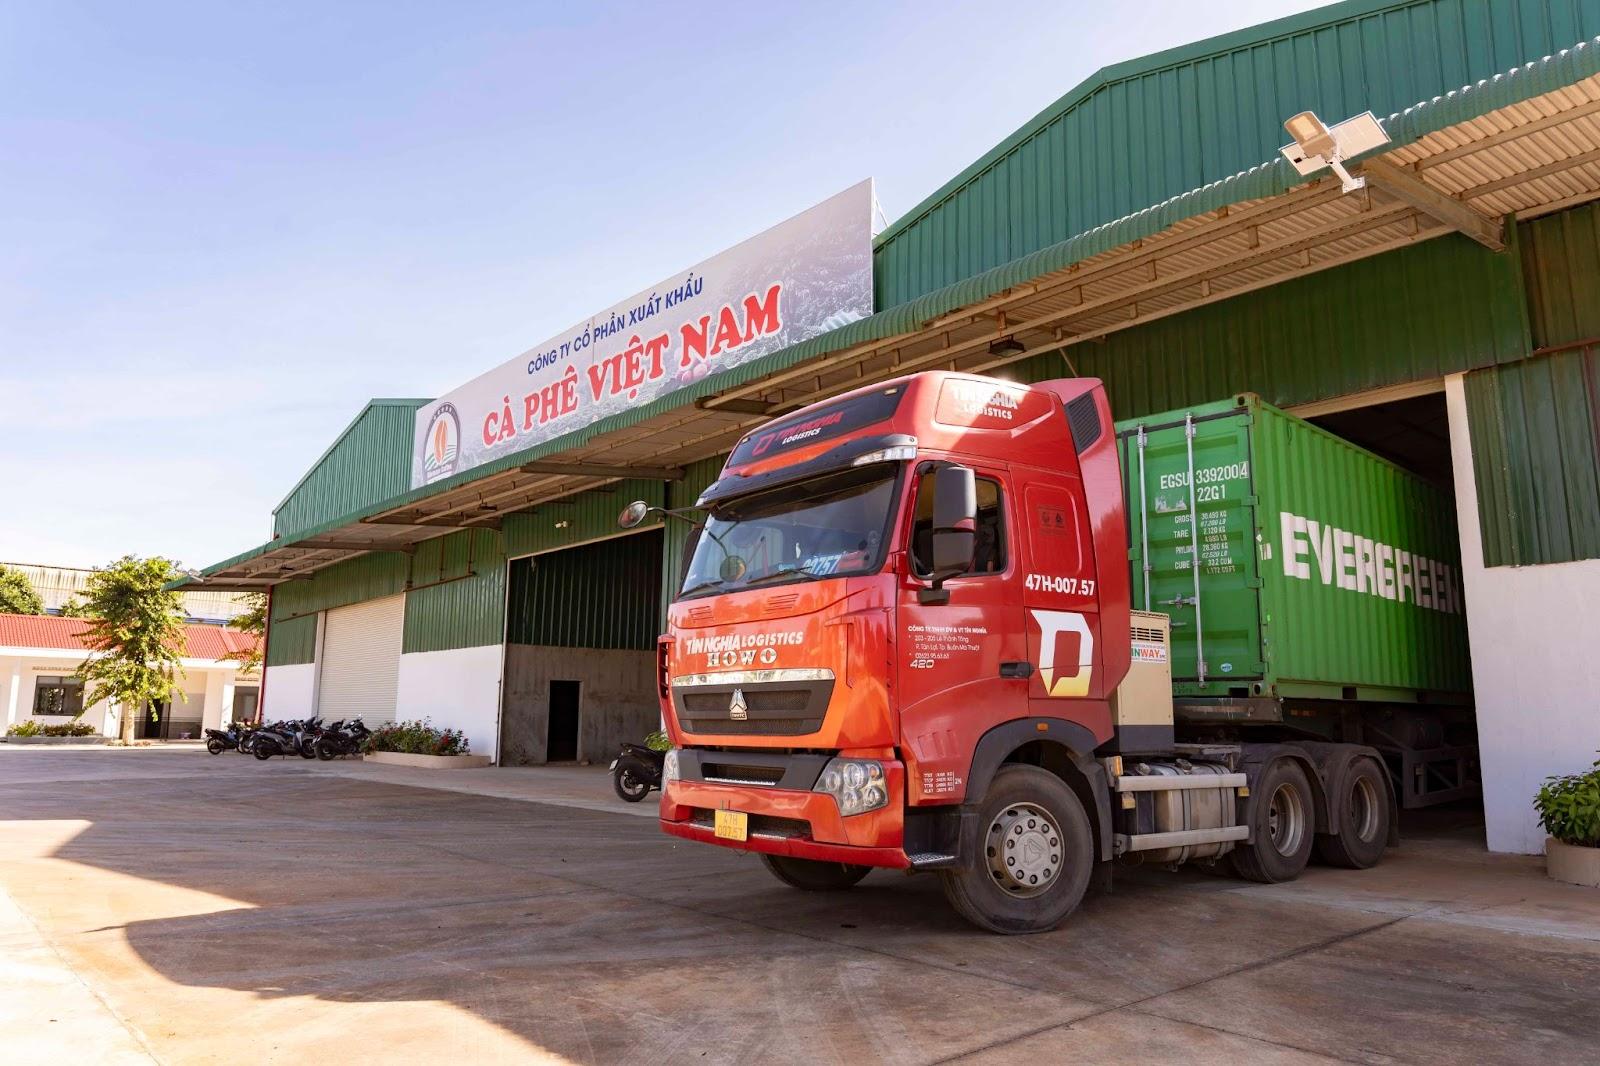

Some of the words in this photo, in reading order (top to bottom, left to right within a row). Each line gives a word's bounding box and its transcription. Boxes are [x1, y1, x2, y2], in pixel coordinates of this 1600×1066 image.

[527, 349, 557, 375] CÔNG
[560, 341, 571, 359] TY
[573, 323, 590, 352] CỔ
[593, 312, 625, 343] PHẦN
[629, 292, 661, 327] XUẤT
[665, 272, 703, 309] KHẨU
[523, 365, 578, 431] PHÊ
[587, 334, 669, 400] VIỆT
[680, 284, 781, 367] NAM
[782, 427, 821, 445] LOGISTICS
[1160, 471, 1191, 489] EGSU
[1197, 484, 1226, 502] 22G1
[1173, 529, 1189, 538] TARE
[1174, 560, 1190, 570] CUBE
[1279, 511, 1461, 616] EVERGREEN
[1025, 573, 1095, 596] 47H-007.57
[741, 631, 804, 648] LOGISTICS
[707, 647, 777, 668] HOWO
[909, 659, 935, 669] 420
